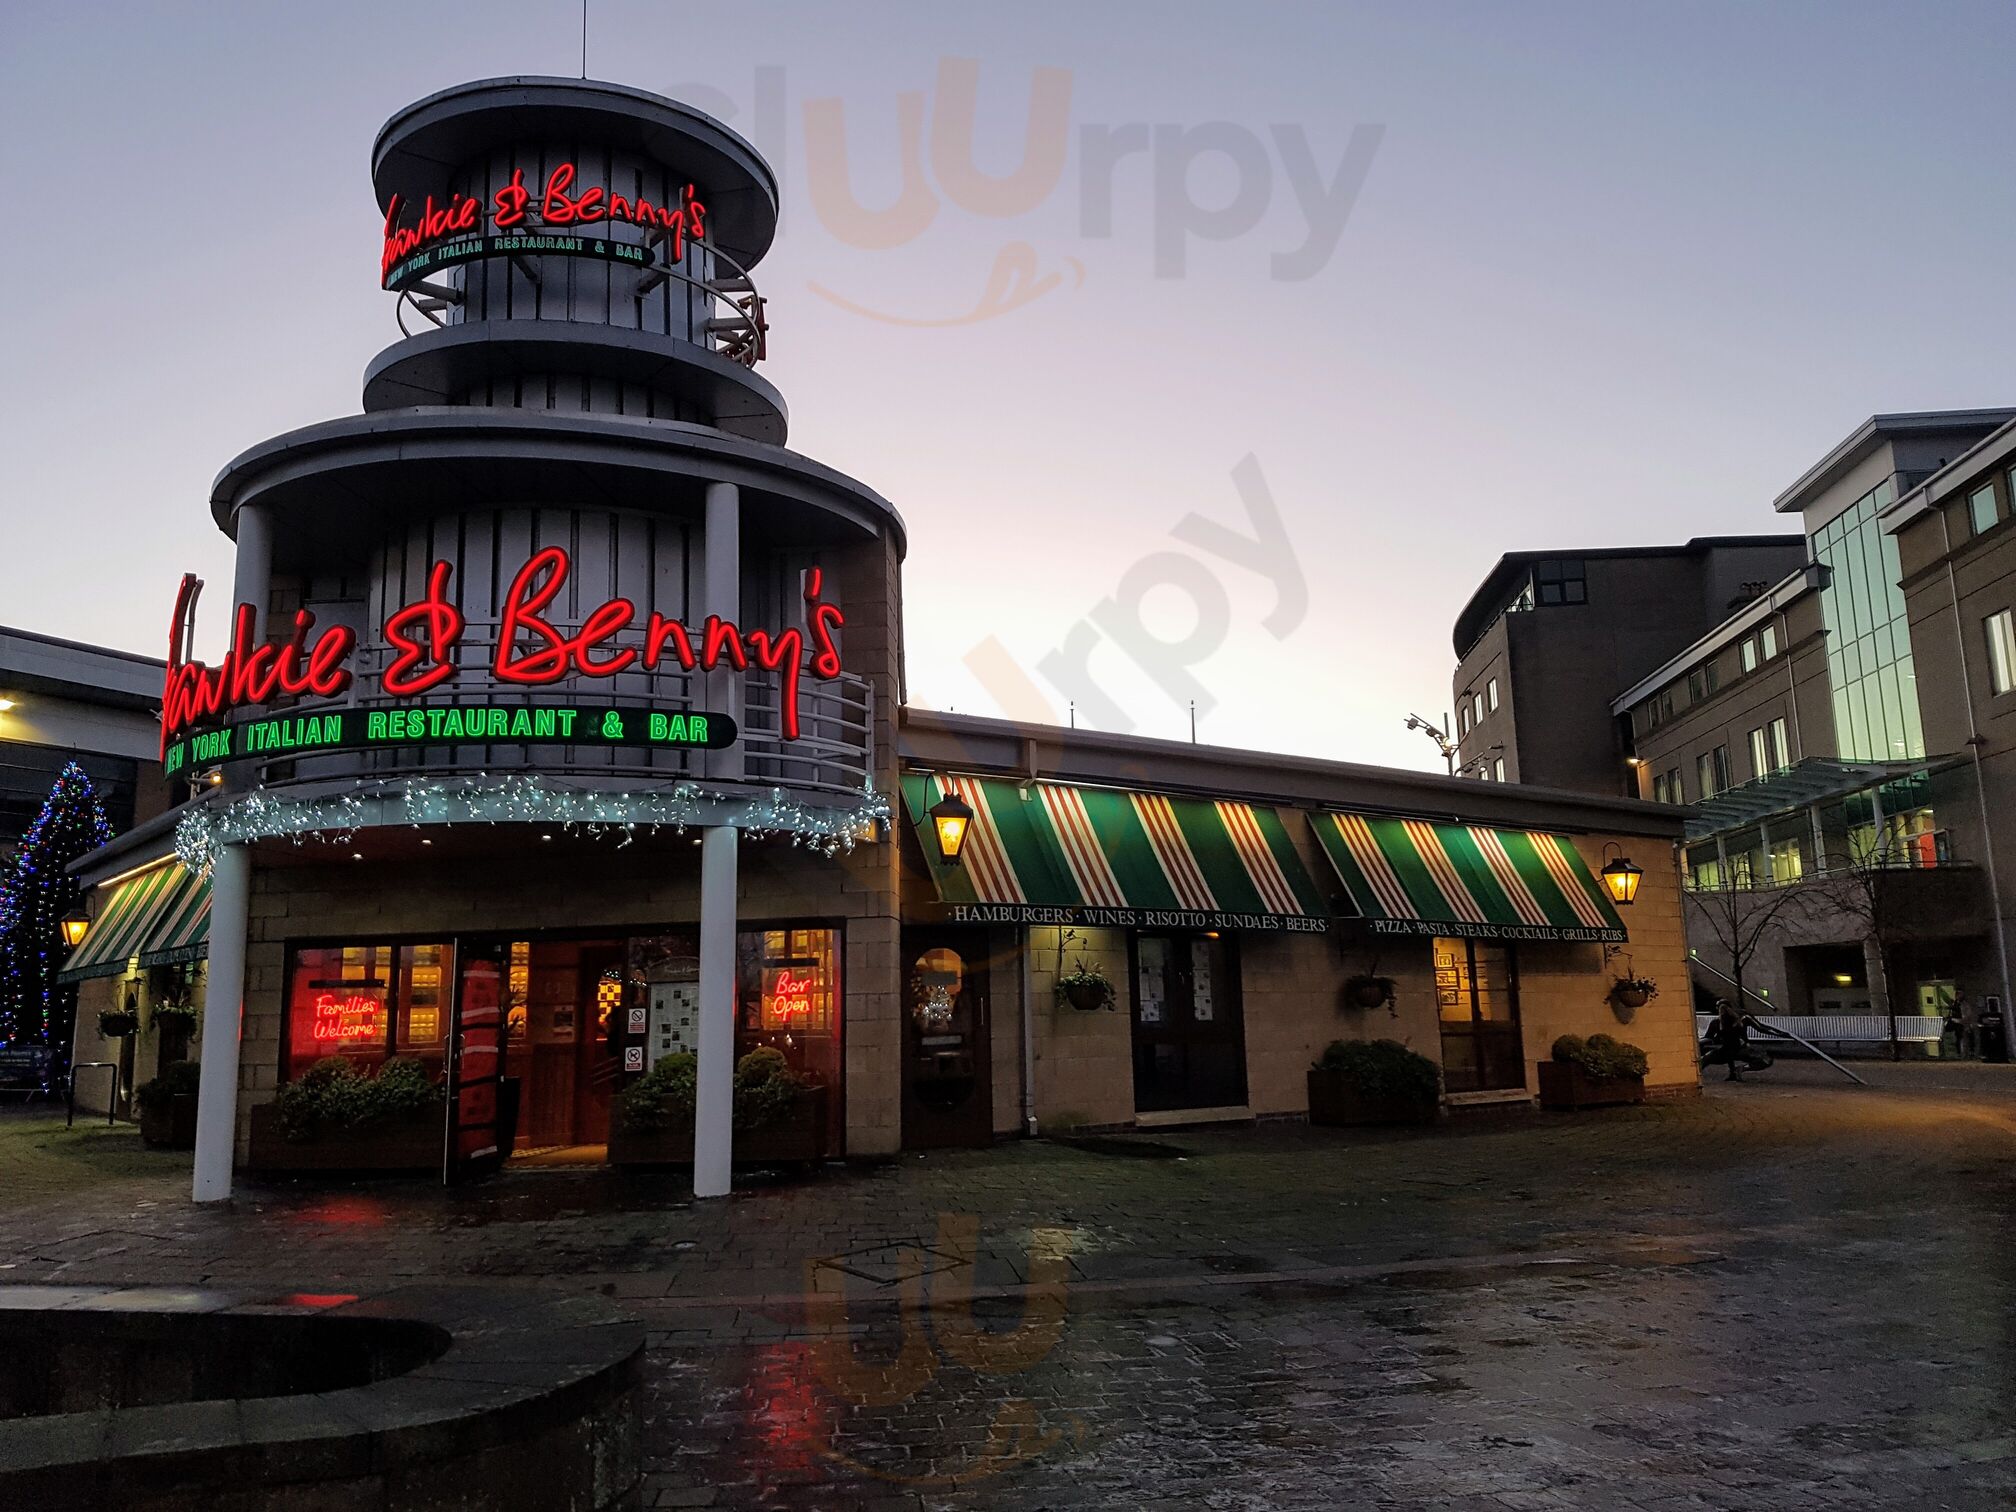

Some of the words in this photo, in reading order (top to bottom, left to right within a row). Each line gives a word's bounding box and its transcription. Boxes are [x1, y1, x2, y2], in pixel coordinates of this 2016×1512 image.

[493, 167, 531, 227] &
[541, 162, 707, 264] Benny's
[407, 251, 431, 272] YORK
[437, 239, 483, 261] ITALIAN
[494, 236, 584, 252] RESTAURANT
[594, 240, 605, 254] &
[615, 243, 643, 261] BAR
[383, 558, 466, 697] &
[493, 545, 845, 741] Benny's
[166, 742, 184, 775] NEW
[191, 728, 233, 763] YORK
[247, 714, 341, 752] ITALIAN
[367, 708, 577, 740] RESTAURANT
[602, 710, 624, 739] &
[650, 712, 708, 743] BAR
[954, 905, 1074, 923] HAMBURGERS
[1084, 909, 1136, 926] WINES
[1145, 912, 1206, 928] RISOTTO
[1214, 914, 1279, 930] SUNDAES
[1286, 917, 1327, 932] BEERS
[1375, 920, 1412, 934] PIZZA
[1417, 922, 1450, 935] PASTA
[1454, 923, 1499, 938] STEAKS
[1501, 925, 1559, 940] COCKTAILS
[1562, 928, 1598, 941] GRILLS
[1601, 929, 1623, 942] RIBS
[776, 971, 811, 995] Bar
[316, 994, 377, 1017] Families
[773, 995, 809, 1021] Open
[314, 1020, 375, 1039] Welcome
